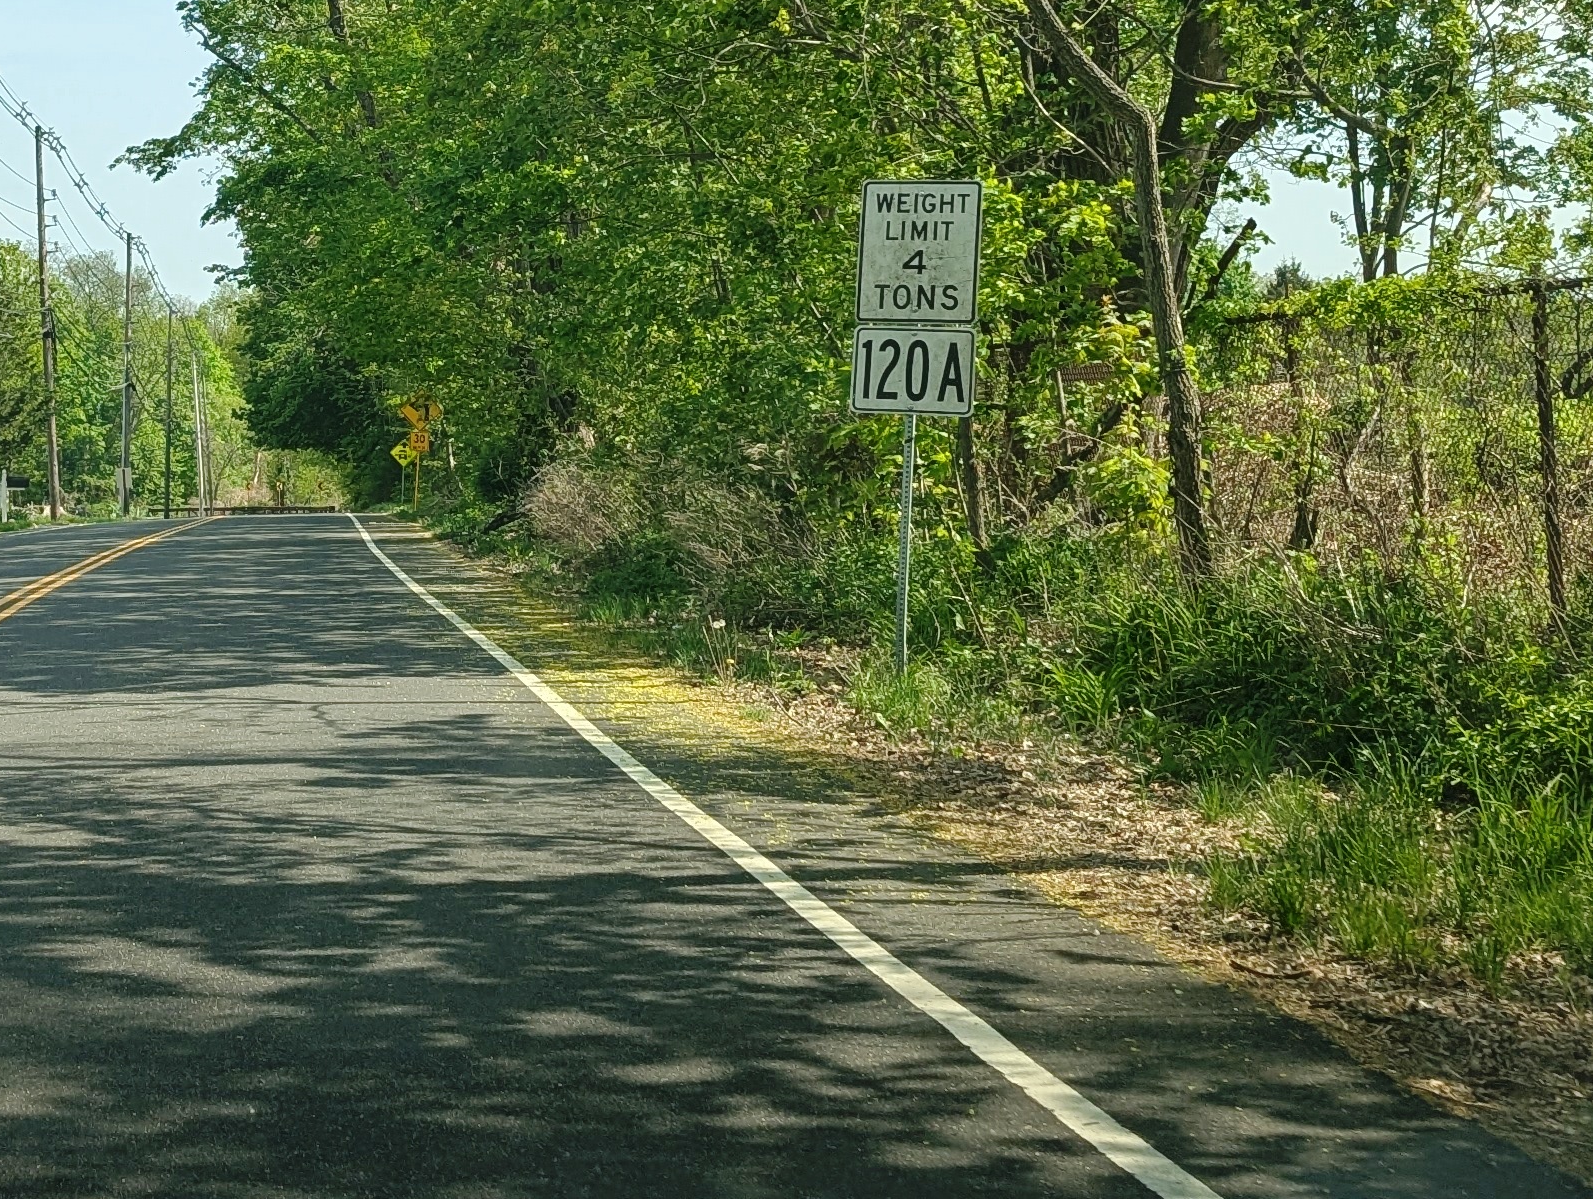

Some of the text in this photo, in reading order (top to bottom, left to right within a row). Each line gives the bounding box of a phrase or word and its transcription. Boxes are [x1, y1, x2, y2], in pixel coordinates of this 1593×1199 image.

[876, 193, 970, 214] WEIGHT
[885, 221, 954, 241] LIMIT
[902, 249, 927, 275] 4
[874, 284, 959, 311] TONS
[862, 338, 965, 403] 120A
[414, 433, 426, 444] 30
